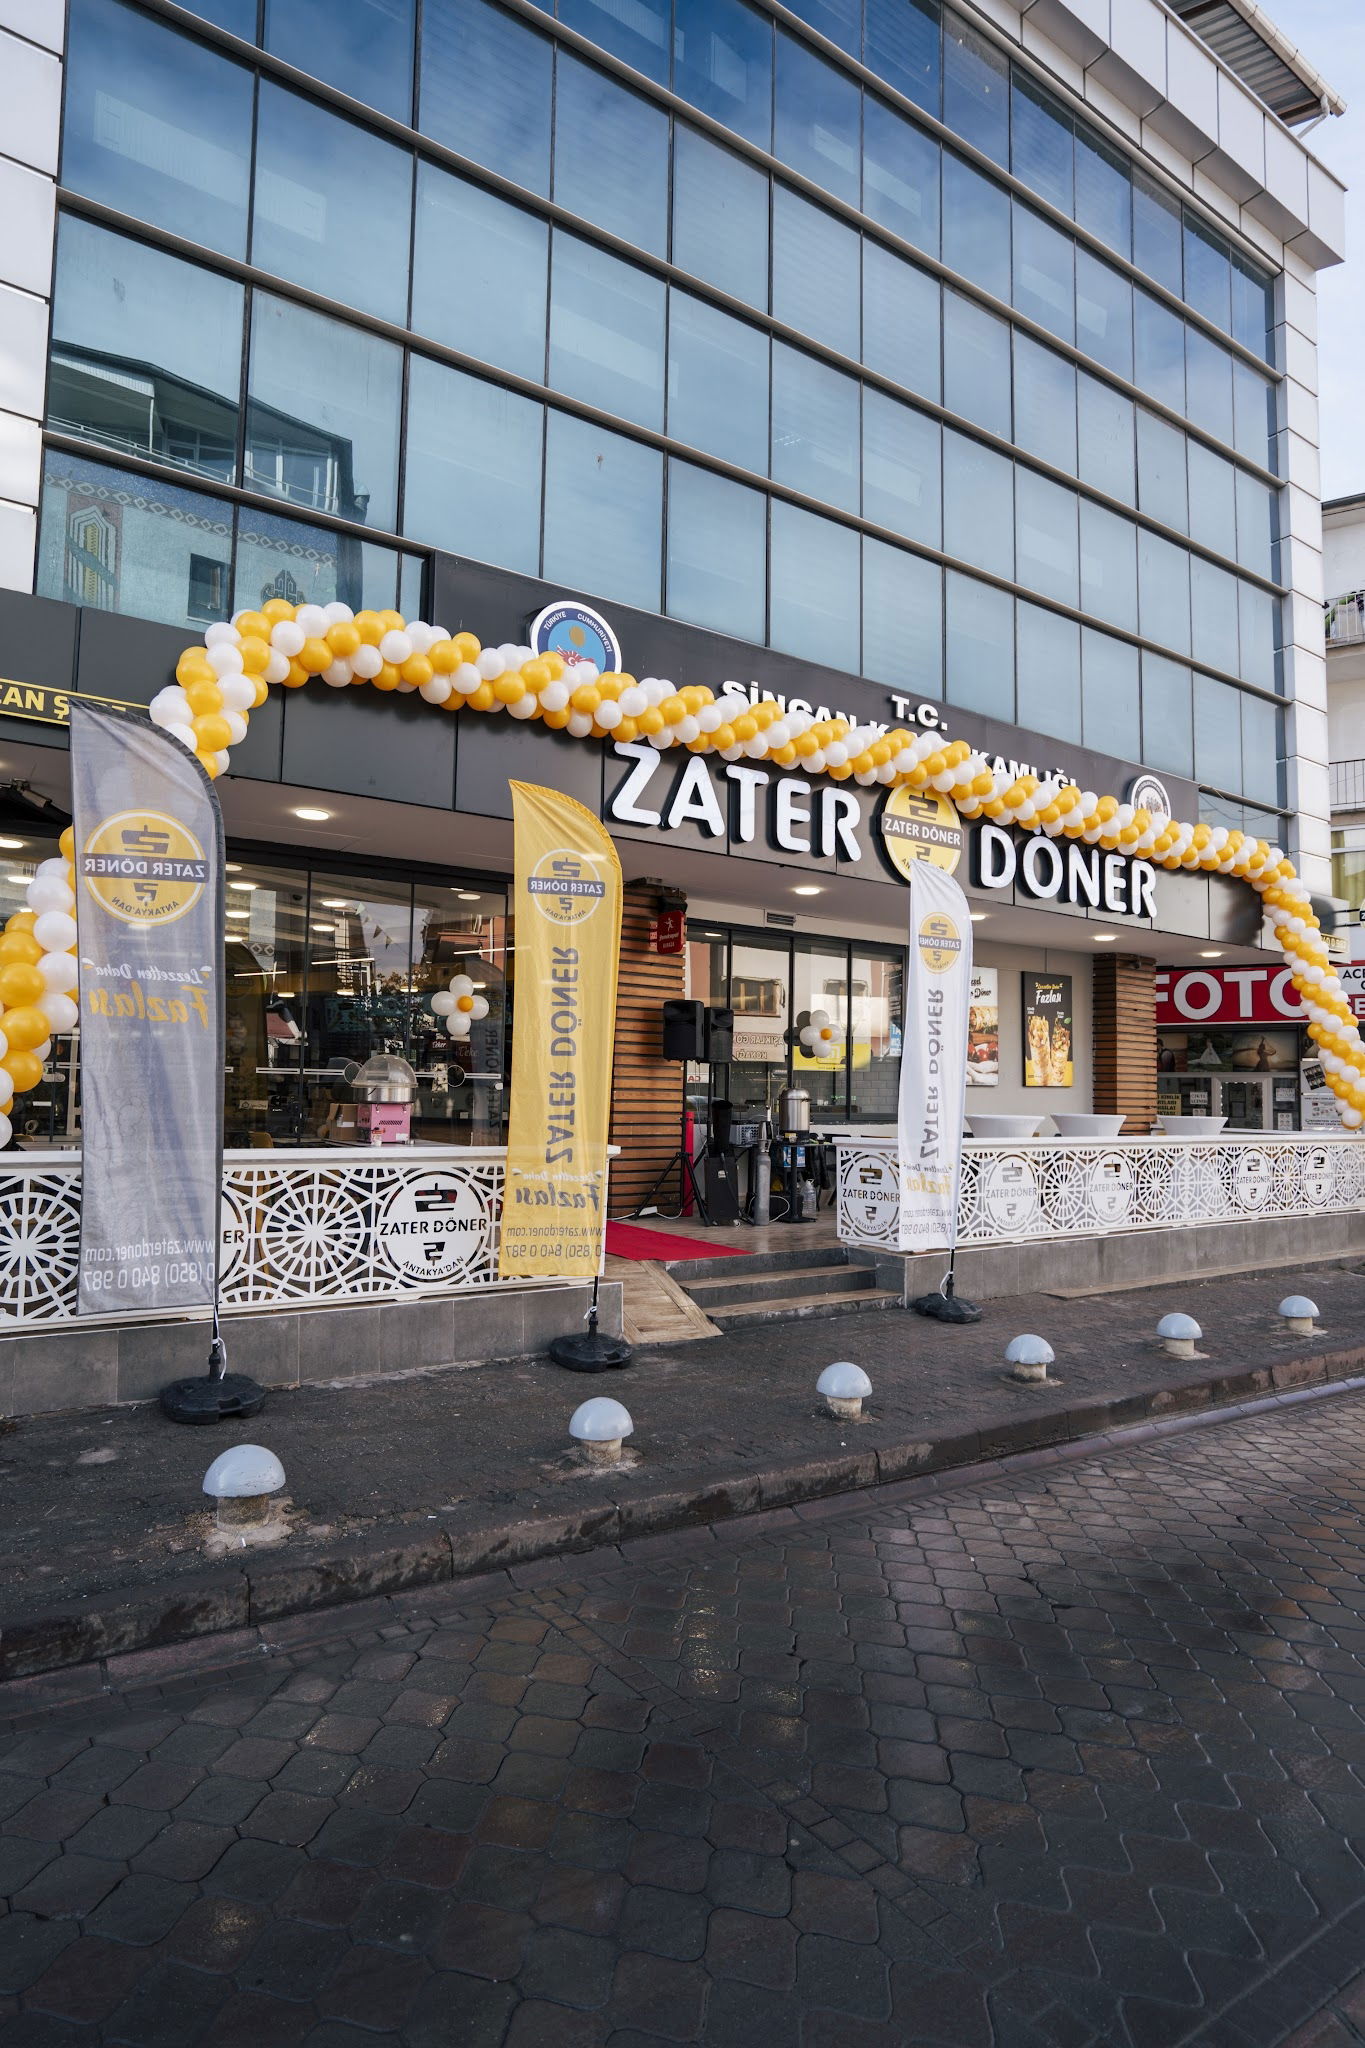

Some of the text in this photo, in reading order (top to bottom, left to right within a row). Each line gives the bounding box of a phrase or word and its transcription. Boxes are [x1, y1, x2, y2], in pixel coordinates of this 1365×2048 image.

[543, 610, 567, 631] TÜRKİYE
[0, 684, 44, 712] AN
[892, 694, 948, 731] T.C.
[611, 742, 1157, 918] ZATER DÖNER
[884, 818, 961, 846] ZATER DÖNER
[843, 1188, 868, 1200] ZATER
[985, 1188, 1010, 1199] ZATER
[1089, 1183, 1110, 1193] ZATER
[379, 1217, 488, 1236] ZATER DÖNER
[402, 1255, 464, 1276] ANTAKYA'DAN
